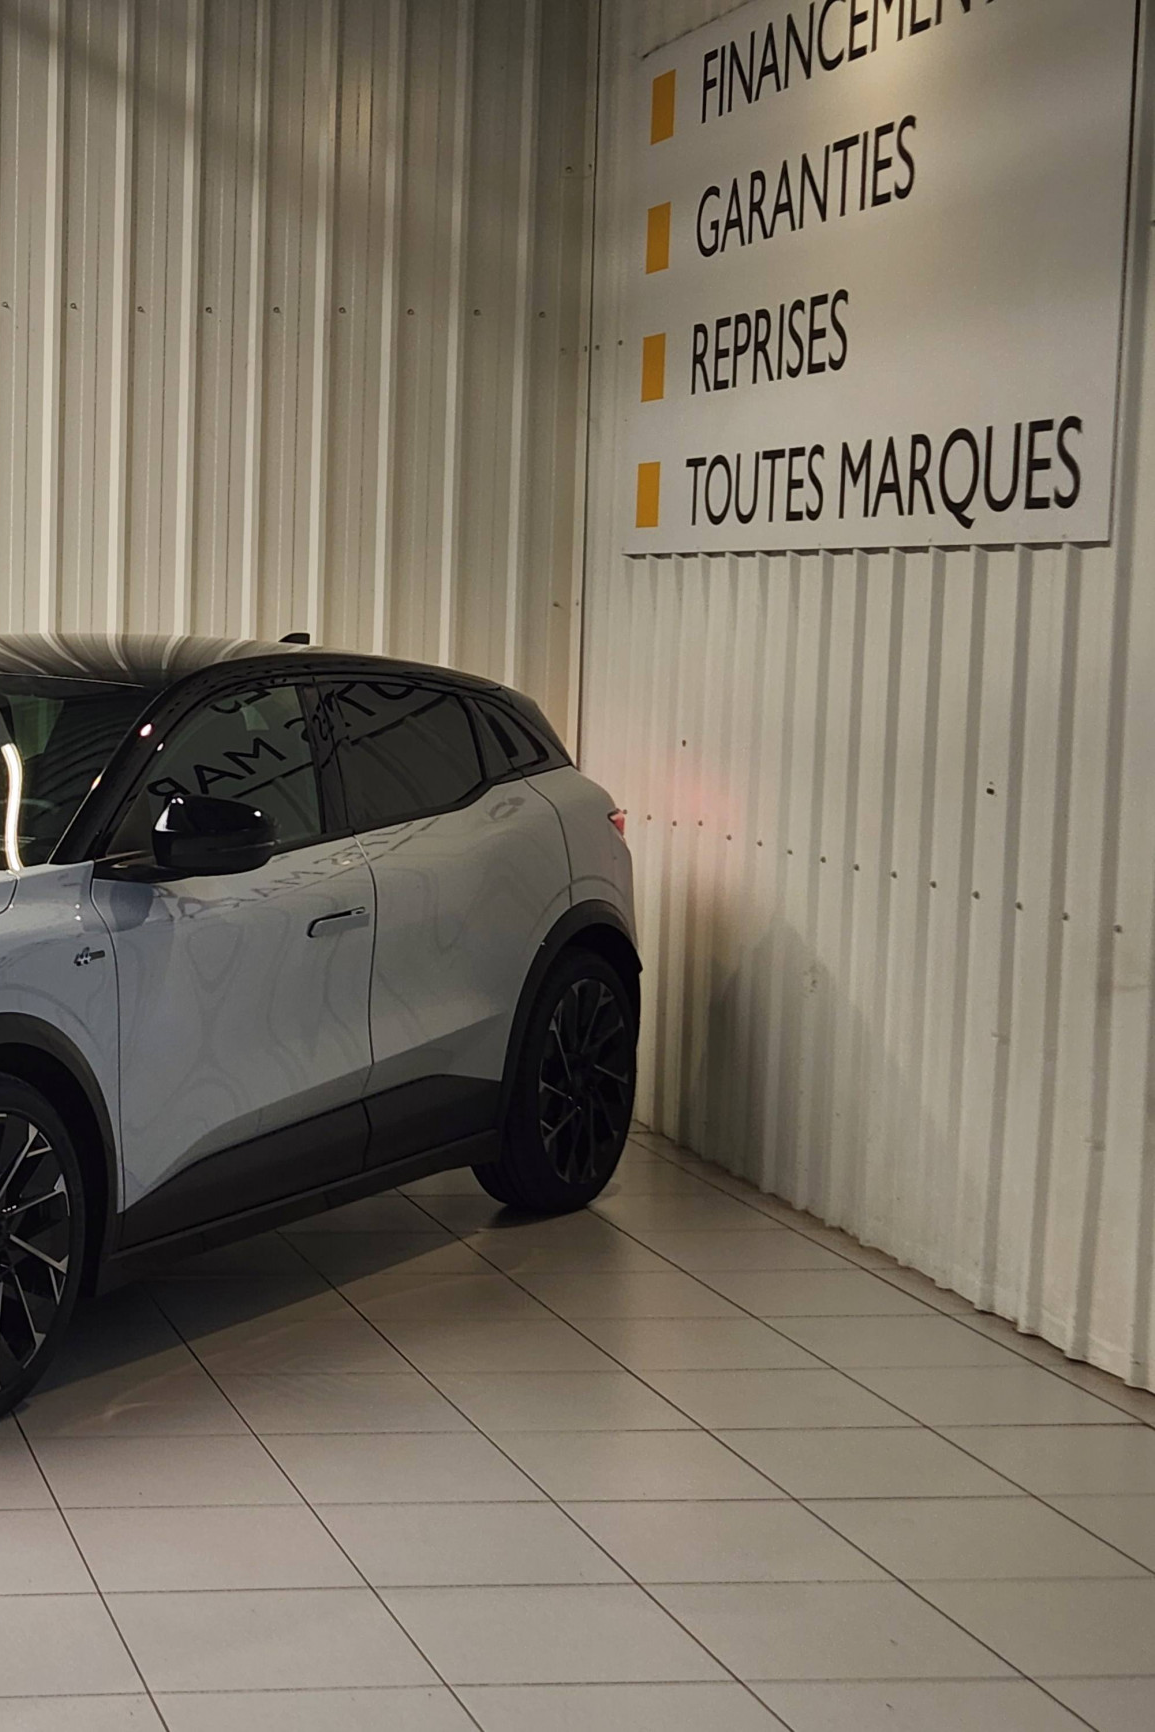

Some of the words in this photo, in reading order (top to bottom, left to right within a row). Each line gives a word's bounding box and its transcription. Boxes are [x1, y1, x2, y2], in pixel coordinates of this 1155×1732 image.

[696, 114, 917, 258] GARANTIES
[691, 288, 849, 395] REPRISES
[685, 444, 825, 526] TOUTES
[838, 415, 1083, 530] MARQUES
